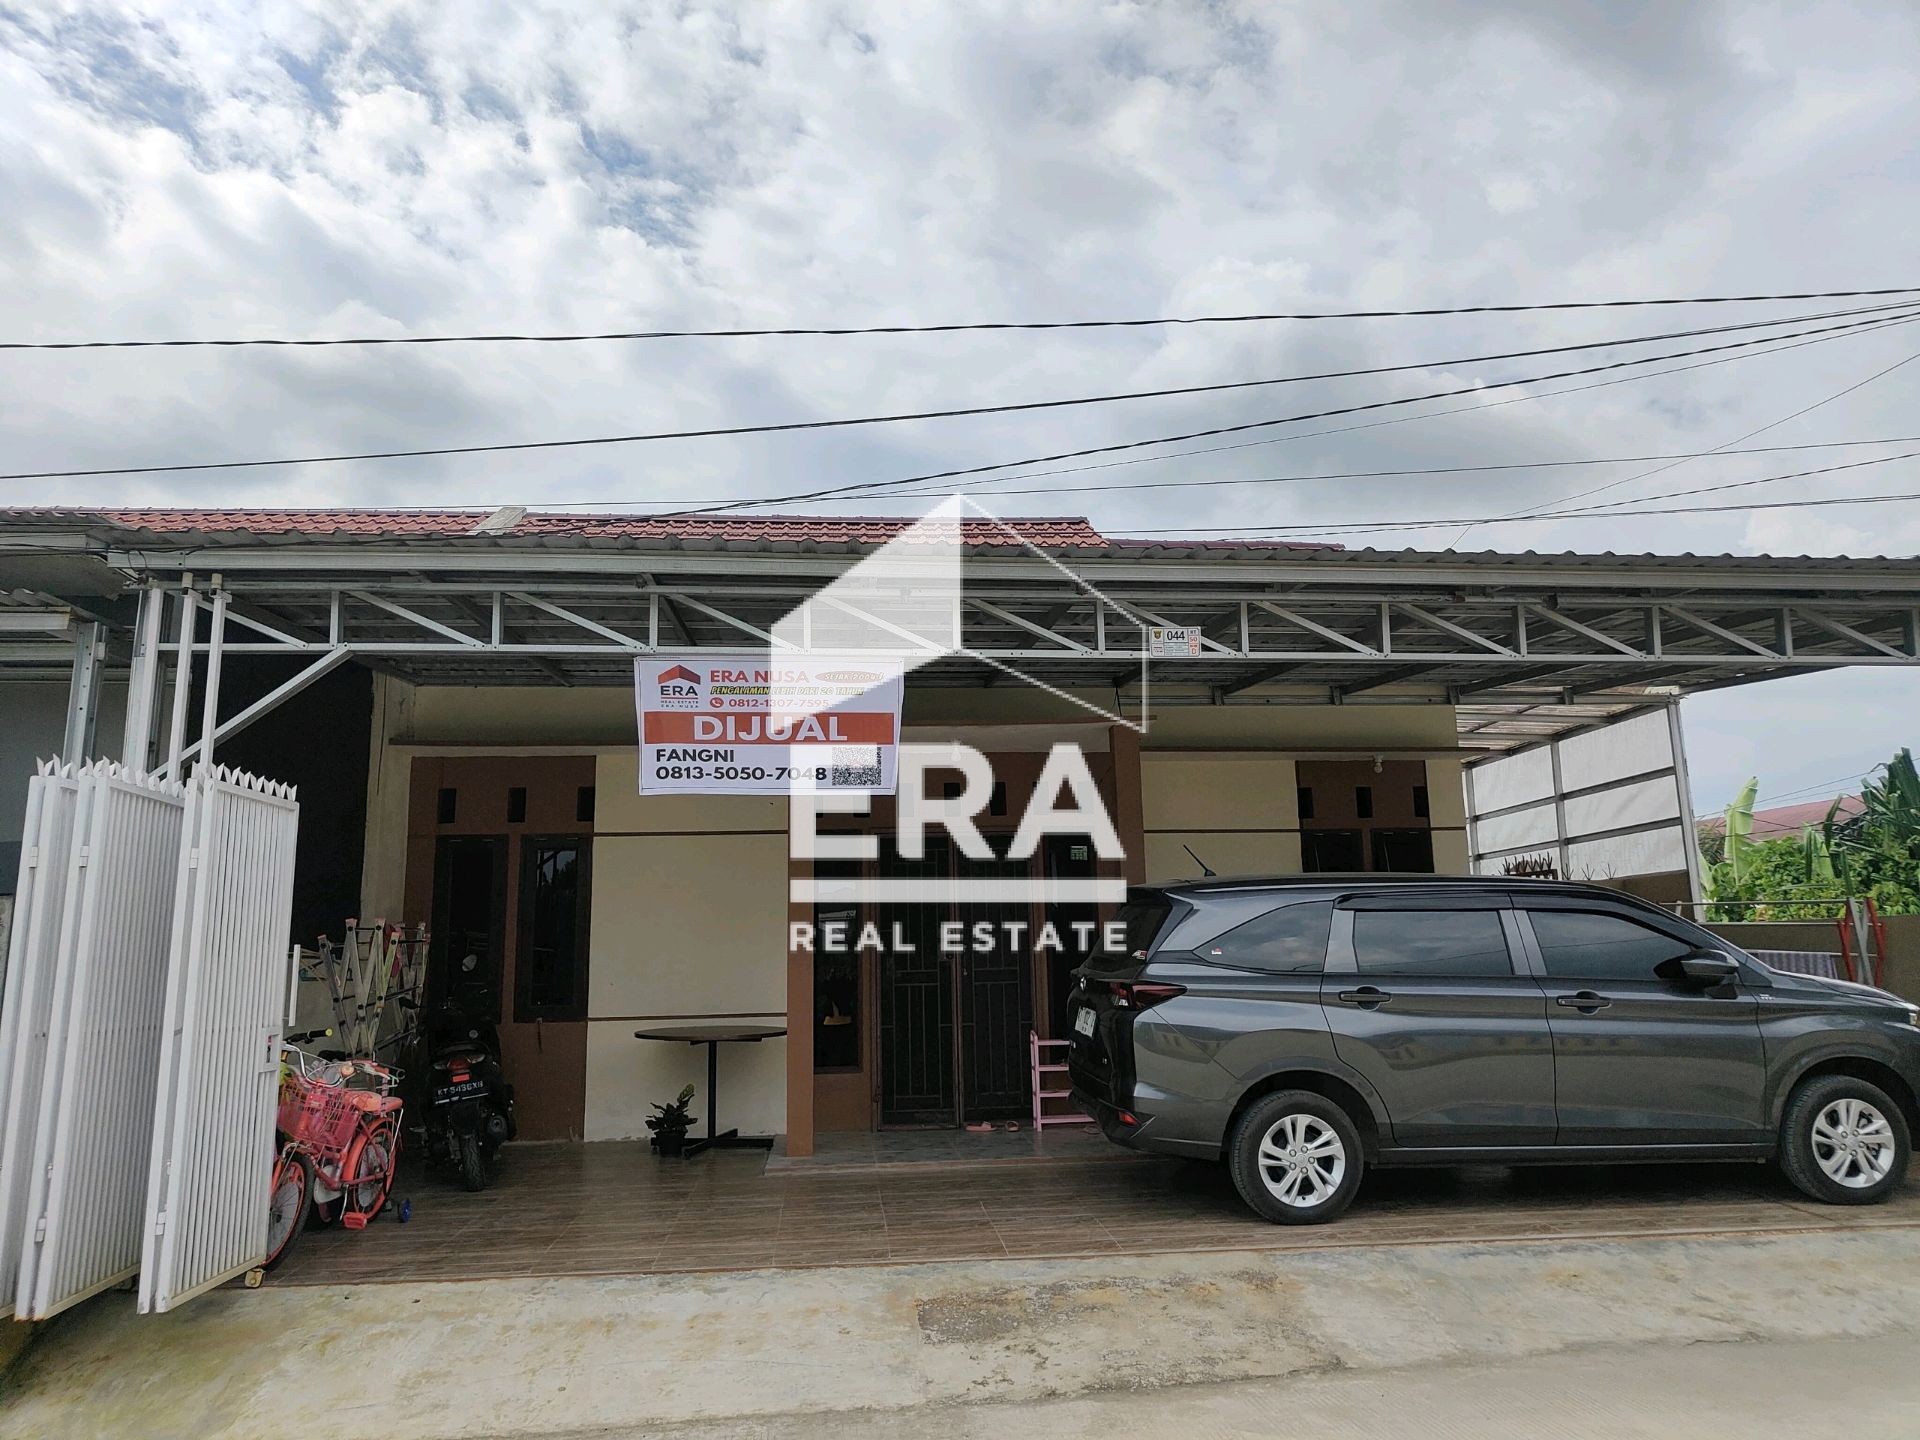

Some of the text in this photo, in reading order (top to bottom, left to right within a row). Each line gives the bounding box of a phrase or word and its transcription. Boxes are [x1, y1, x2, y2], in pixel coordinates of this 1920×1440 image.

[1166, 630, 1185, 641] 044
[710, 670, 809, 683] ERA NUSA
[660, 685, 699, 696] ERA
[709, 685, 772, 696] PENGALAMAN
[771, 686, 797, 696] LEBIH
[835, 686, 865, 696] TAHUN
[728, 698, 830, 708] 0812-1307-7595
[693, 715, 849, 742] DIJUAL
[655, 748, 735, 763] FANGNI
[655, 766, 828, 781] 0813-5050-7048
